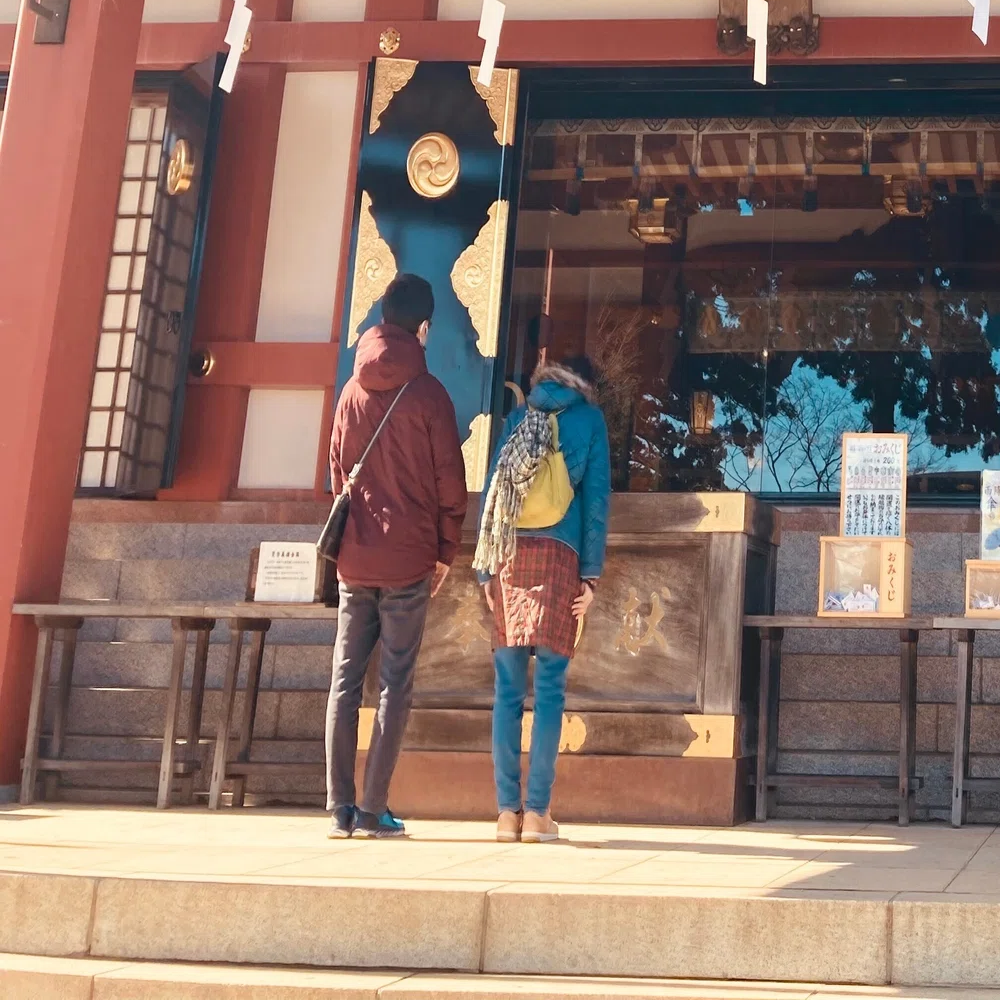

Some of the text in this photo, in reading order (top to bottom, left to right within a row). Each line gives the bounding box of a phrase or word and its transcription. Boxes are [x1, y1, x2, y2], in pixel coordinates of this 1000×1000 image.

[873, 443, 902, 455] おみくじ
[888, 552, 897, 601] おみくじ
